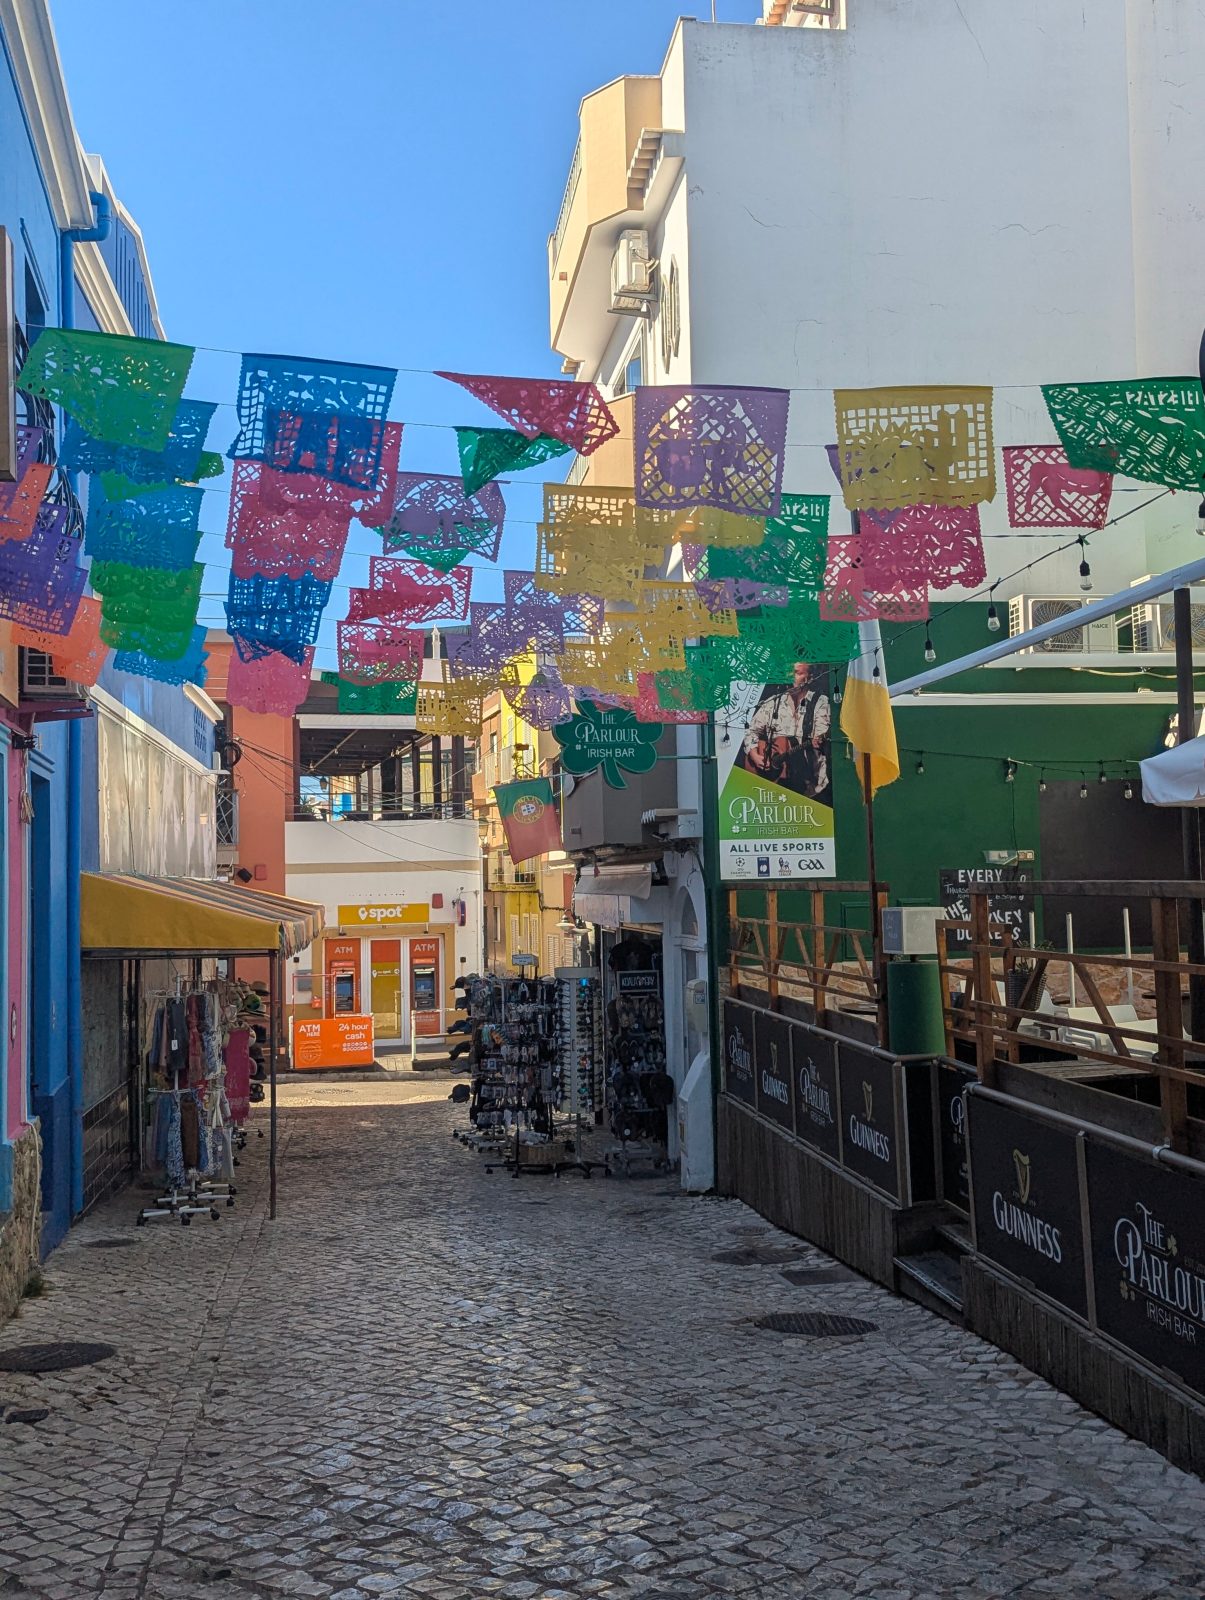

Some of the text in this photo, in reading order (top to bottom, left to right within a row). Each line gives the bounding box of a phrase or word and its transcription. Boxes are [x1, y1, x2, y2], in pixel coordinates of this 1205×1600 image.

[595, 710, 617, 725] THE
[575, 721, 645, 745] PARLOUR
[587, 748, 635, 758] IRISH BAR
[752, 786, 777, 803] THE
[729, 796, 825, 827] PARLOUR
[757, 826, 800, 835] IRISH BAR
[730, 842, 825, 853] ALL LIVE SPORTS
[958, 869, 1003, 883] EVERY
[369, 905, 403, 922] spot
[334, 946, 353, 954] ATM
[413, 943, 436, 952] ATM
[299, 1024, 321, 1033] ATM
[338, 1023, 369, 1032] 24 hour
[345, 1031, 366, 1040] cash
[762, 1069, 788, 1105] GUINNESS
[800, 1067, 834, 1124] PARLOUR
[850, 1113, 890, 1163] GUINNESS
[993, 1190, 1063, 1265] GUINNESS
[1135, 1201, 1166, 1251] THE
[1146, 1299, 1197, 1343] IRISH BAR
